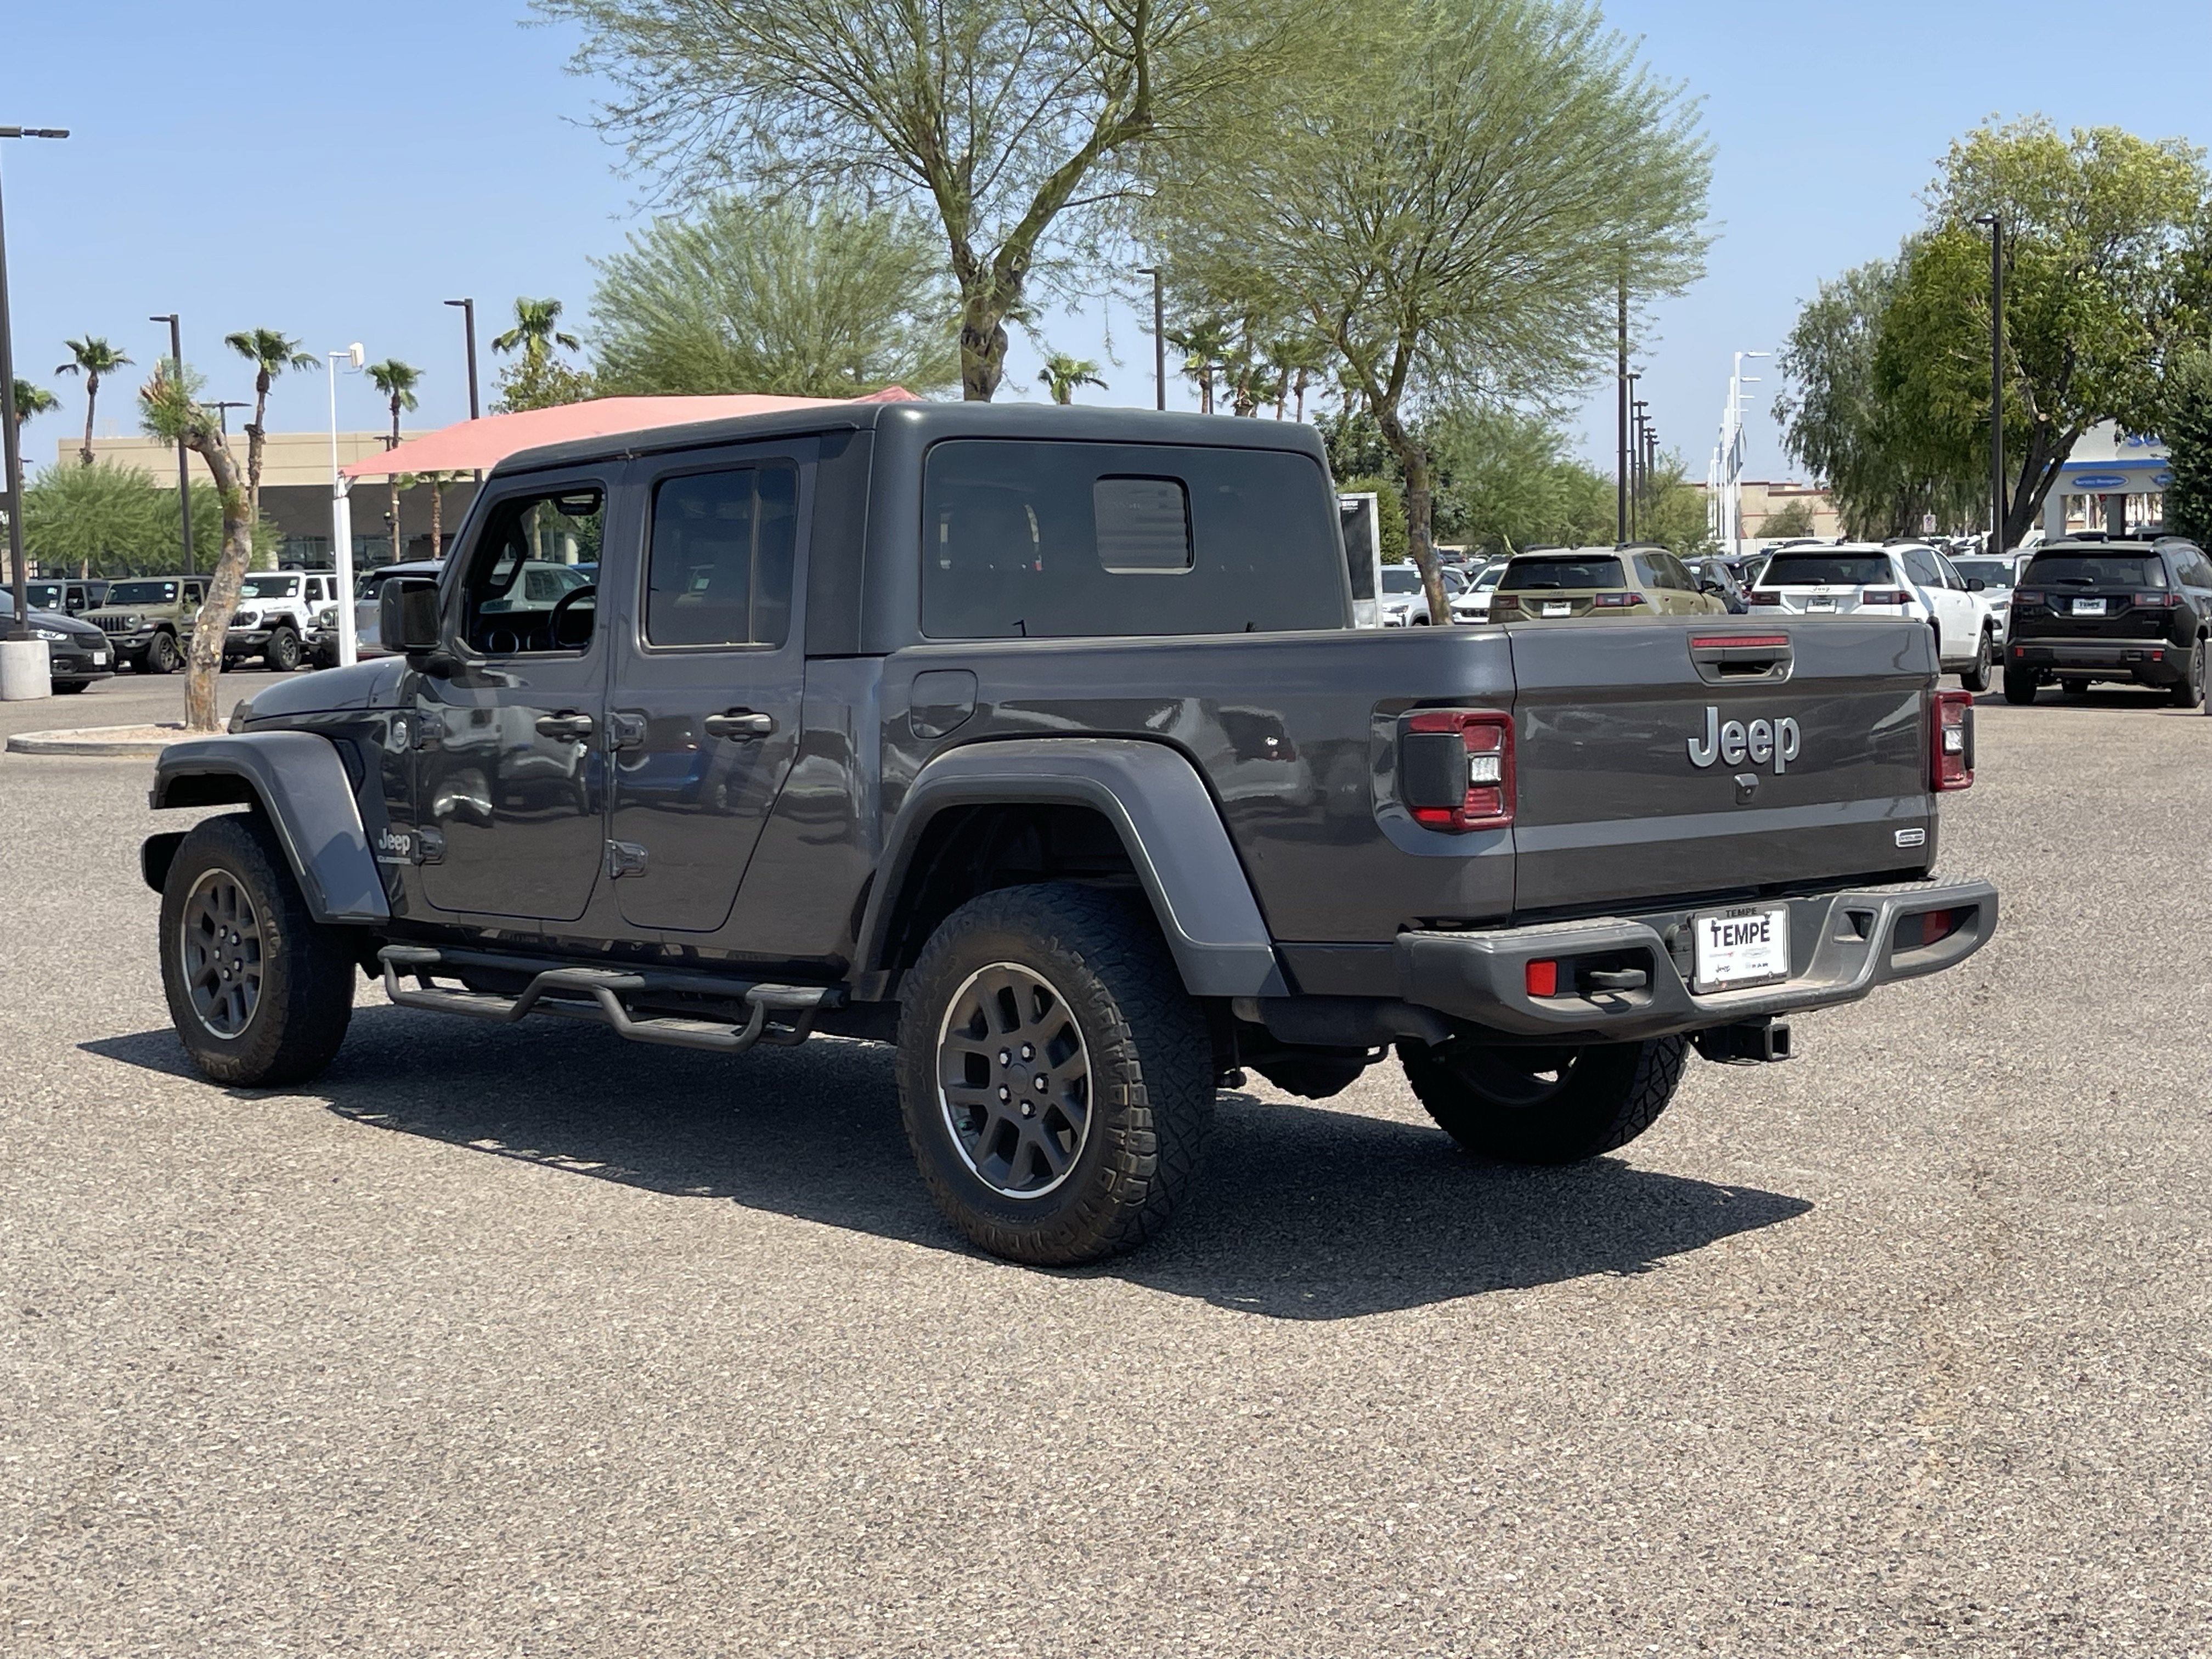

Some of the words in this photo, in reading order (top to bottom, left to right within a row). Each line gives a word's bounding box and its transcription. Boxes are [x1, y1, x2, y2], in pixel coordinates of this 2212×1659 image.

[1687, 706, 1801, 774] Jeep
[379, 828, 410, 855] Jeep
[1726, 907, 1758, 918] TEMPE
[1711, 921, 1770, 947] TEMPE
